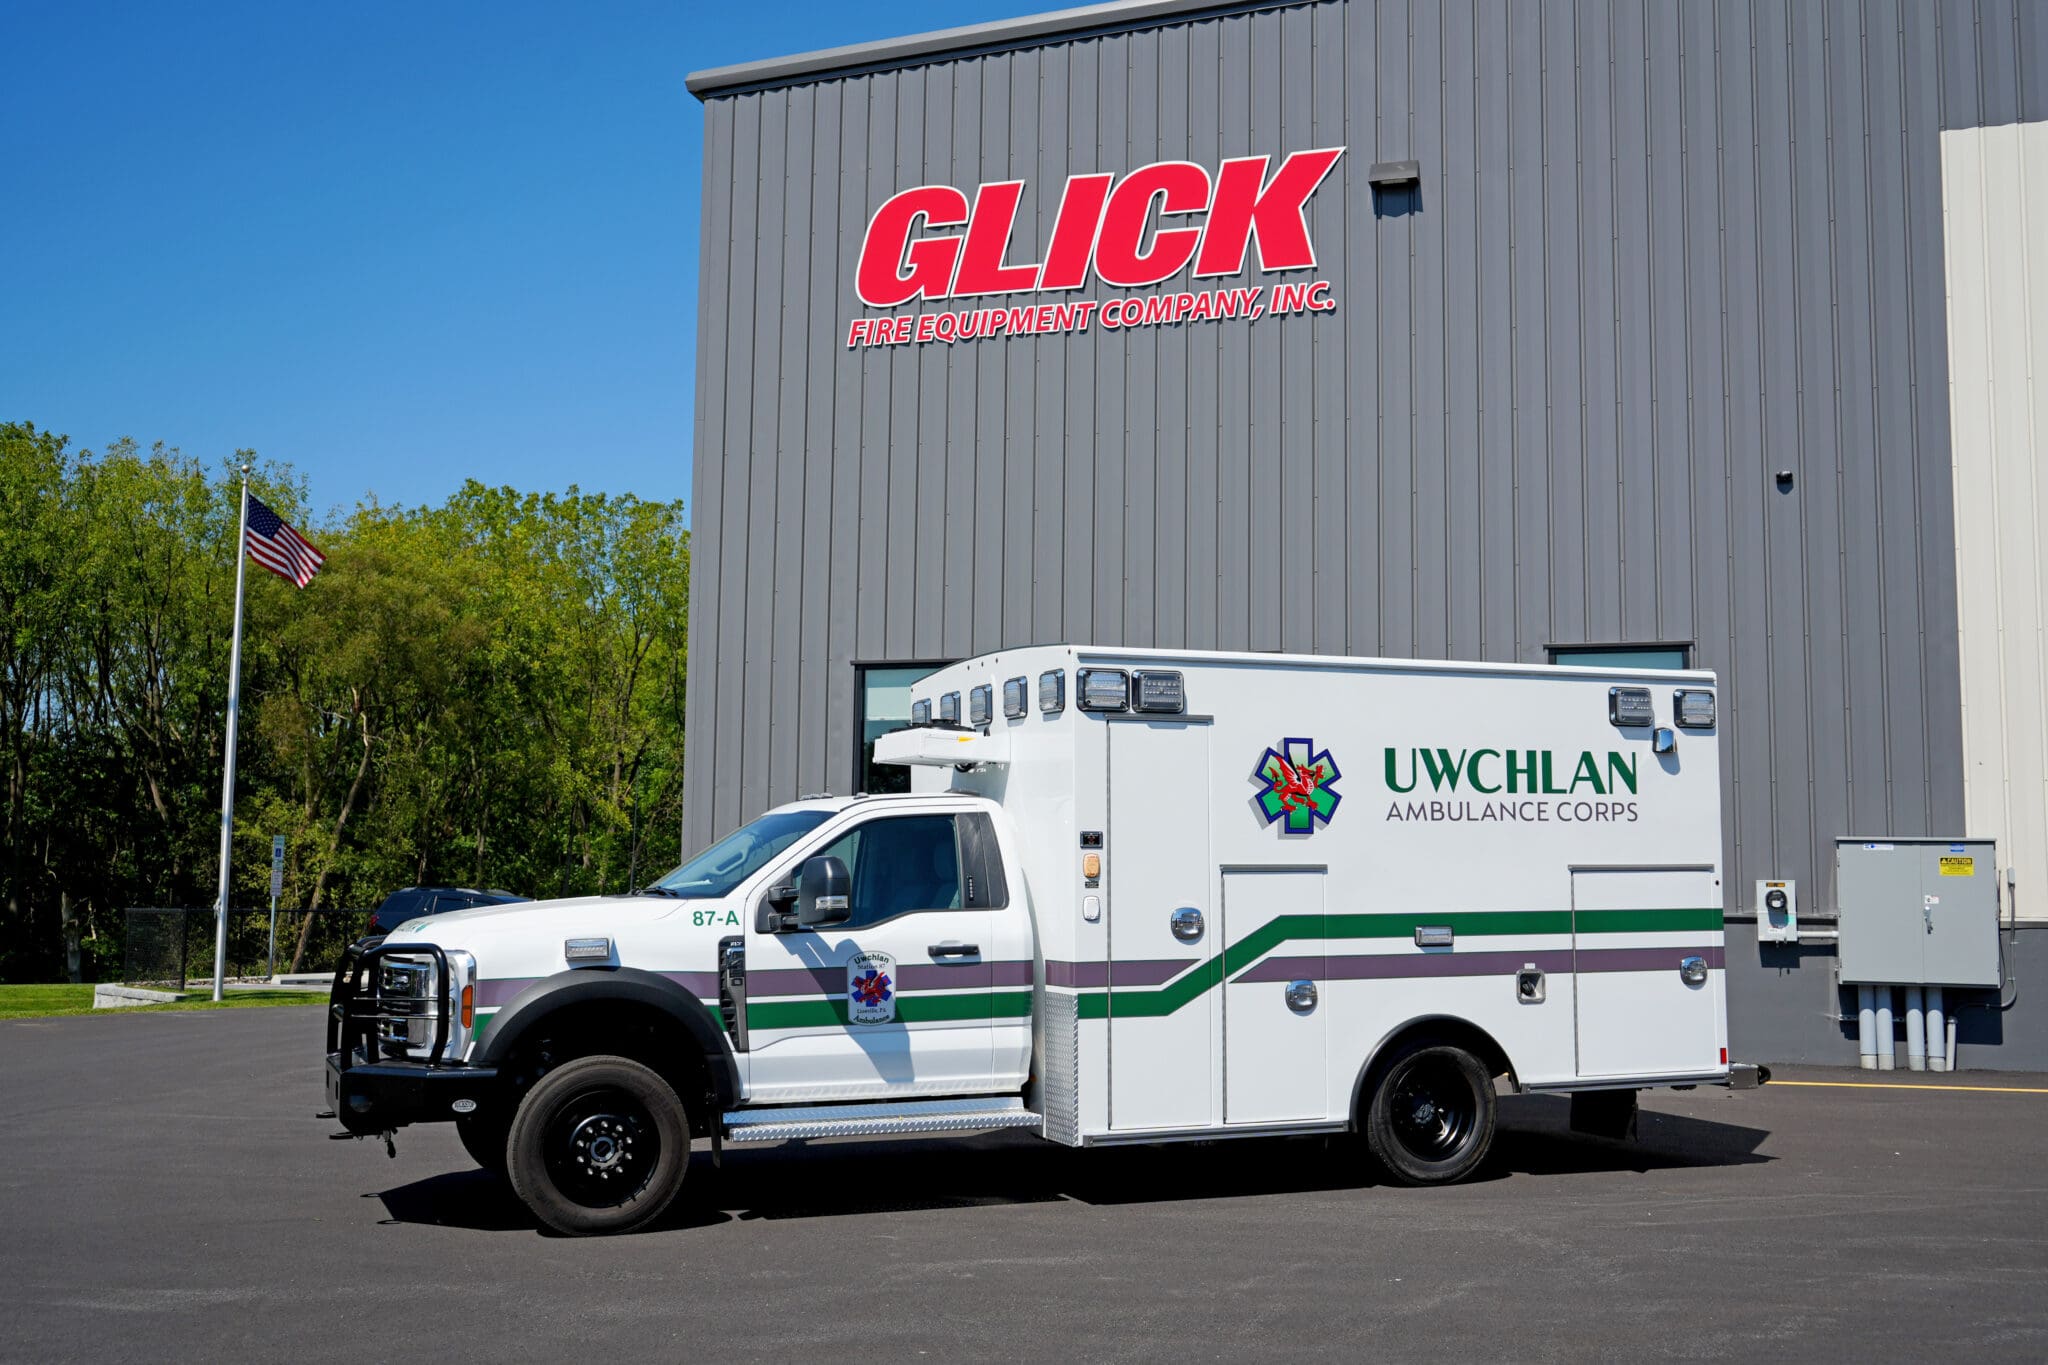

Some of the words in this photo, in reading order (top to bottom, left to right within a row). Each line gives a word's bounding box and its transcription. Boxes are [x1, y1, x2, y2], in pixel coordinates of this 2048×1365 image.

[855, 146, 1347, 308] GLICK
[847, 315, 913, 347] FIRE
[915, 301, 1097, 343] EQUIPMENT
[1100, 286, 1263, 328] COMPANY,
[1269, 281, 1336, 314] INC.
[1384, 747, 1638, 795] UWCHLAN
[1386, 801, 1549, 821] AMBULANCE
[1556, 802, 1639, 822] CORPS
[692, 910, 740, 926] 87-A
[854, 953, 889, 964] Uwchlan
[853, 1014, 890, 1024] Ambulance
